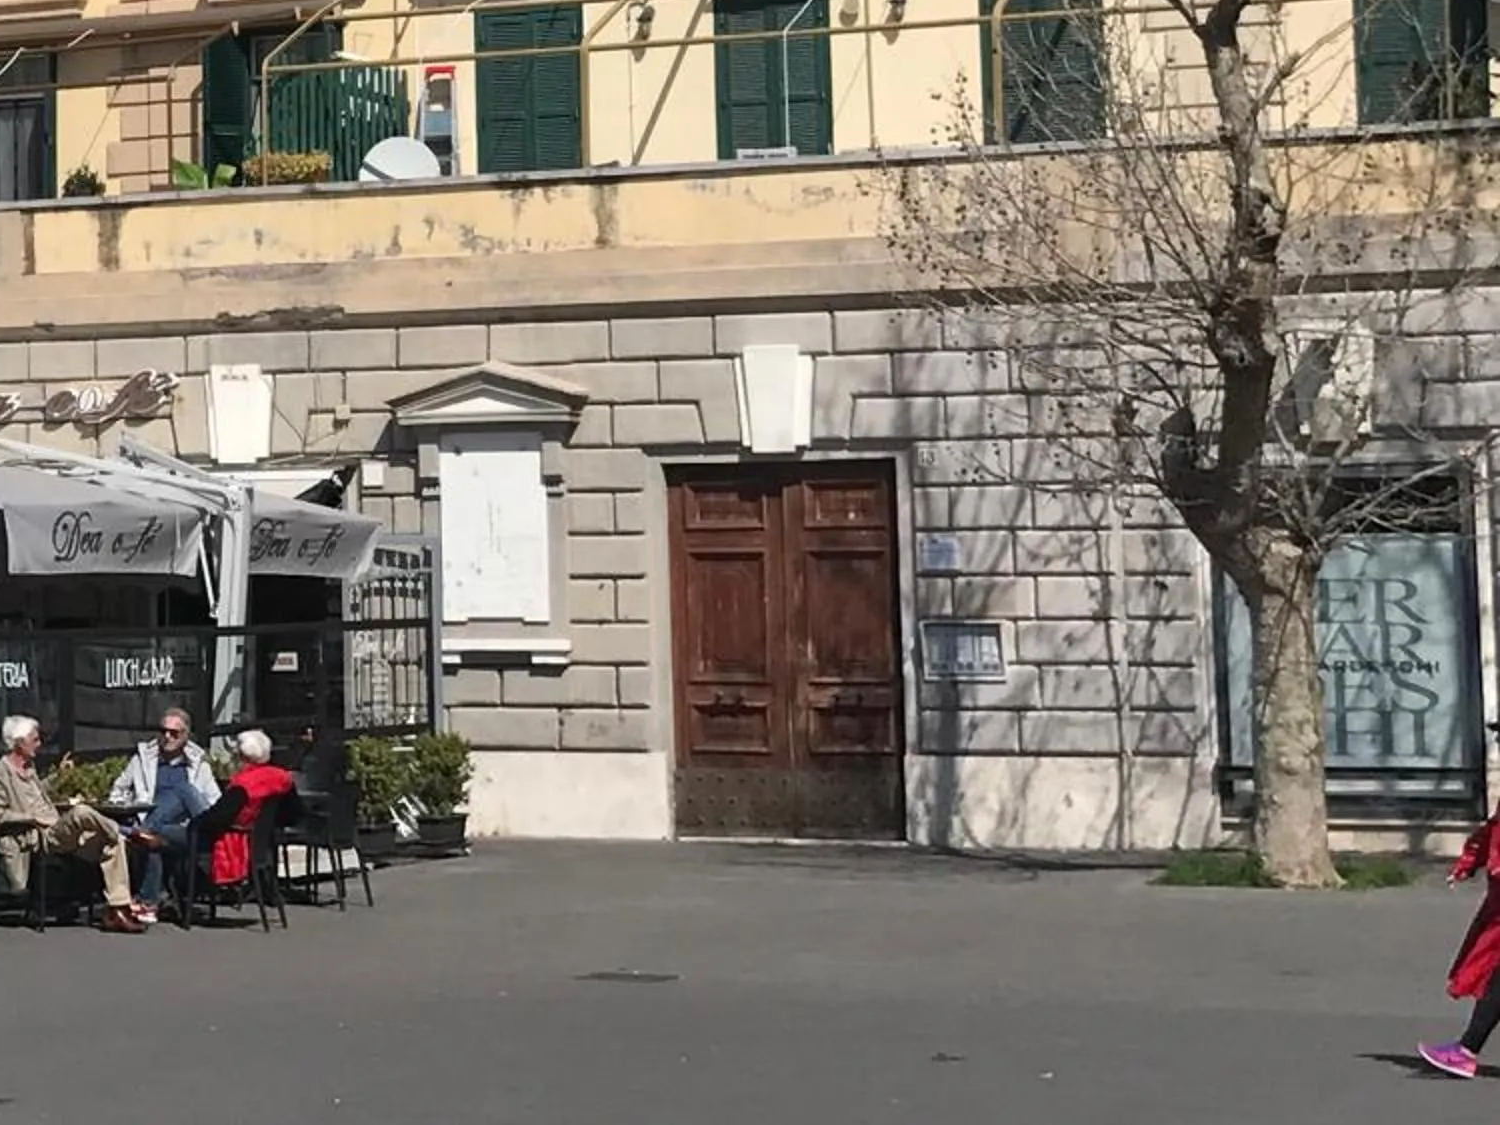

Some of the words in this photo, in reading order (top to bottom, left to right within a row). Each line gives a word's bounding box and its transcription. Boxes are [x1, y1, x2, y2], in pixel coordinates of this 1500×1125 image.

[52, 510, 102, 563] Dea
[105, 658, 140, 688] LUNCH
[151, 655, 174, 686] BAR
